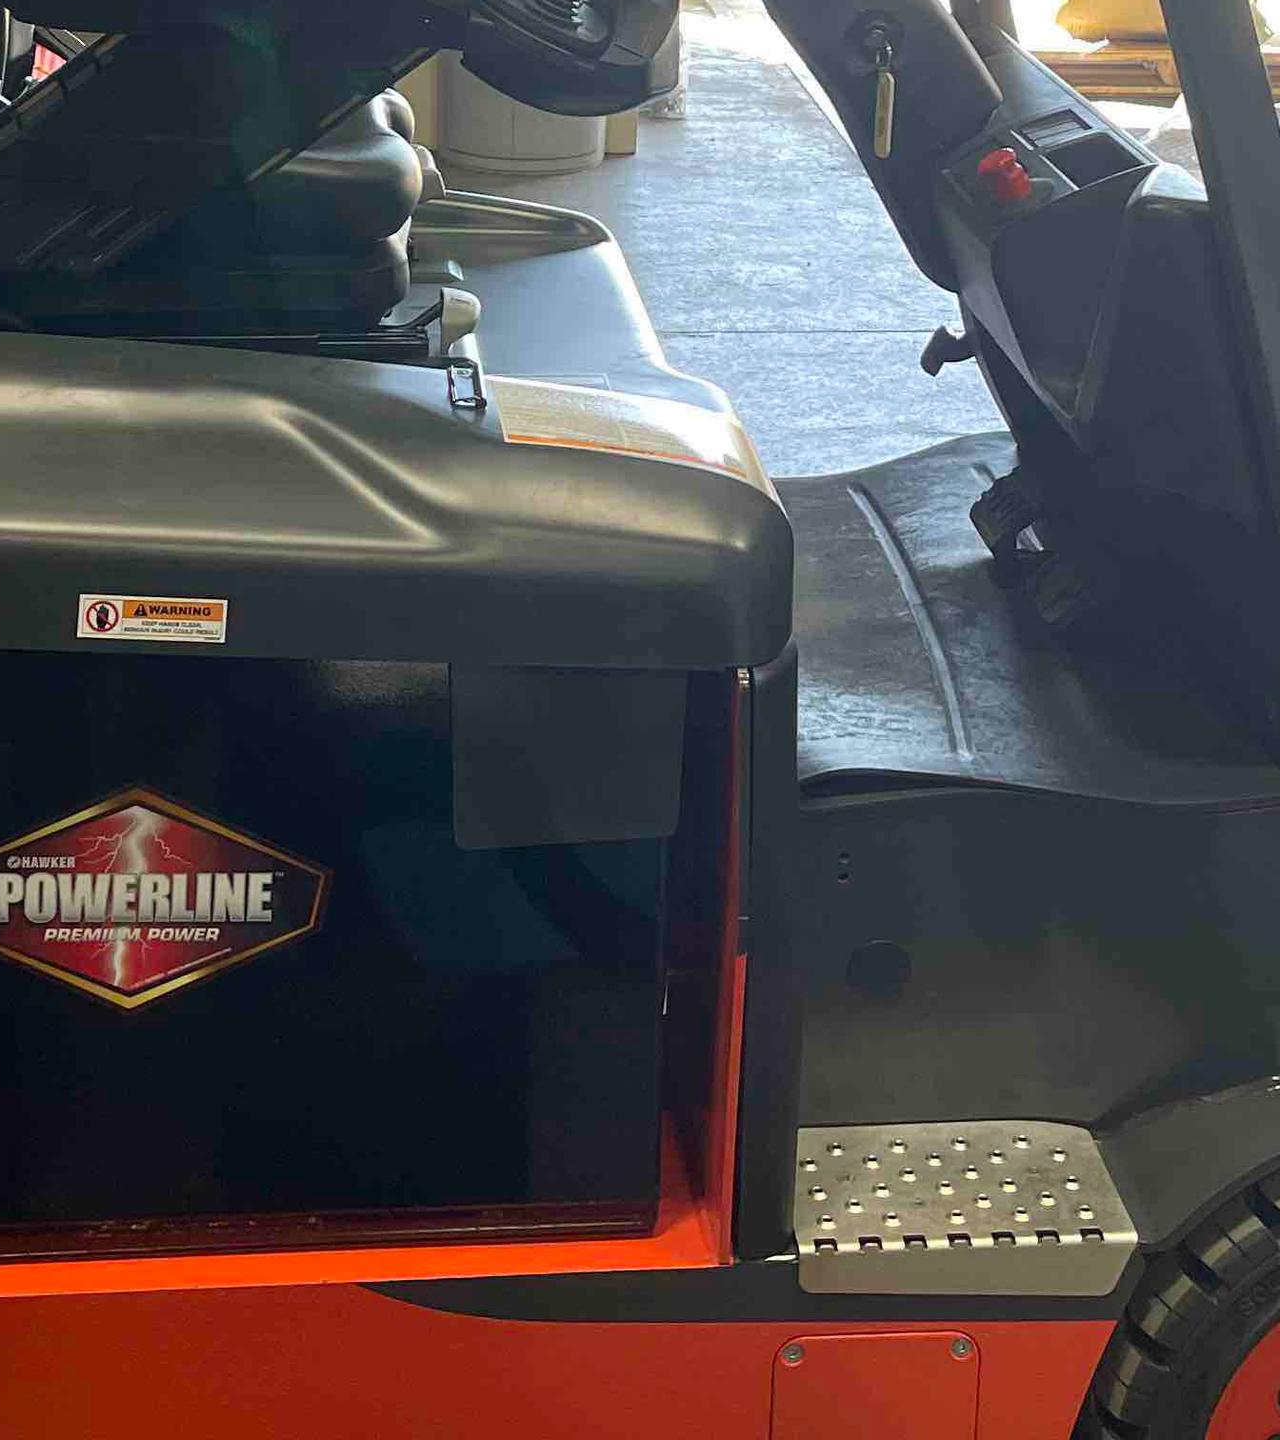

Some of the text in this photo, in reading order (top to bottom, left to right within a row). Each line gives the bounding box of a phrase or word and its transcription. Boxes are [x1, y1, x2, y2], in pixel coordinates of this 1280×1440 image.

[148, 605, 212, 617] WARNING
[22, 856, 76, 869] HAWKER
[43, 927, 220, 942] PREMIUM POWER
